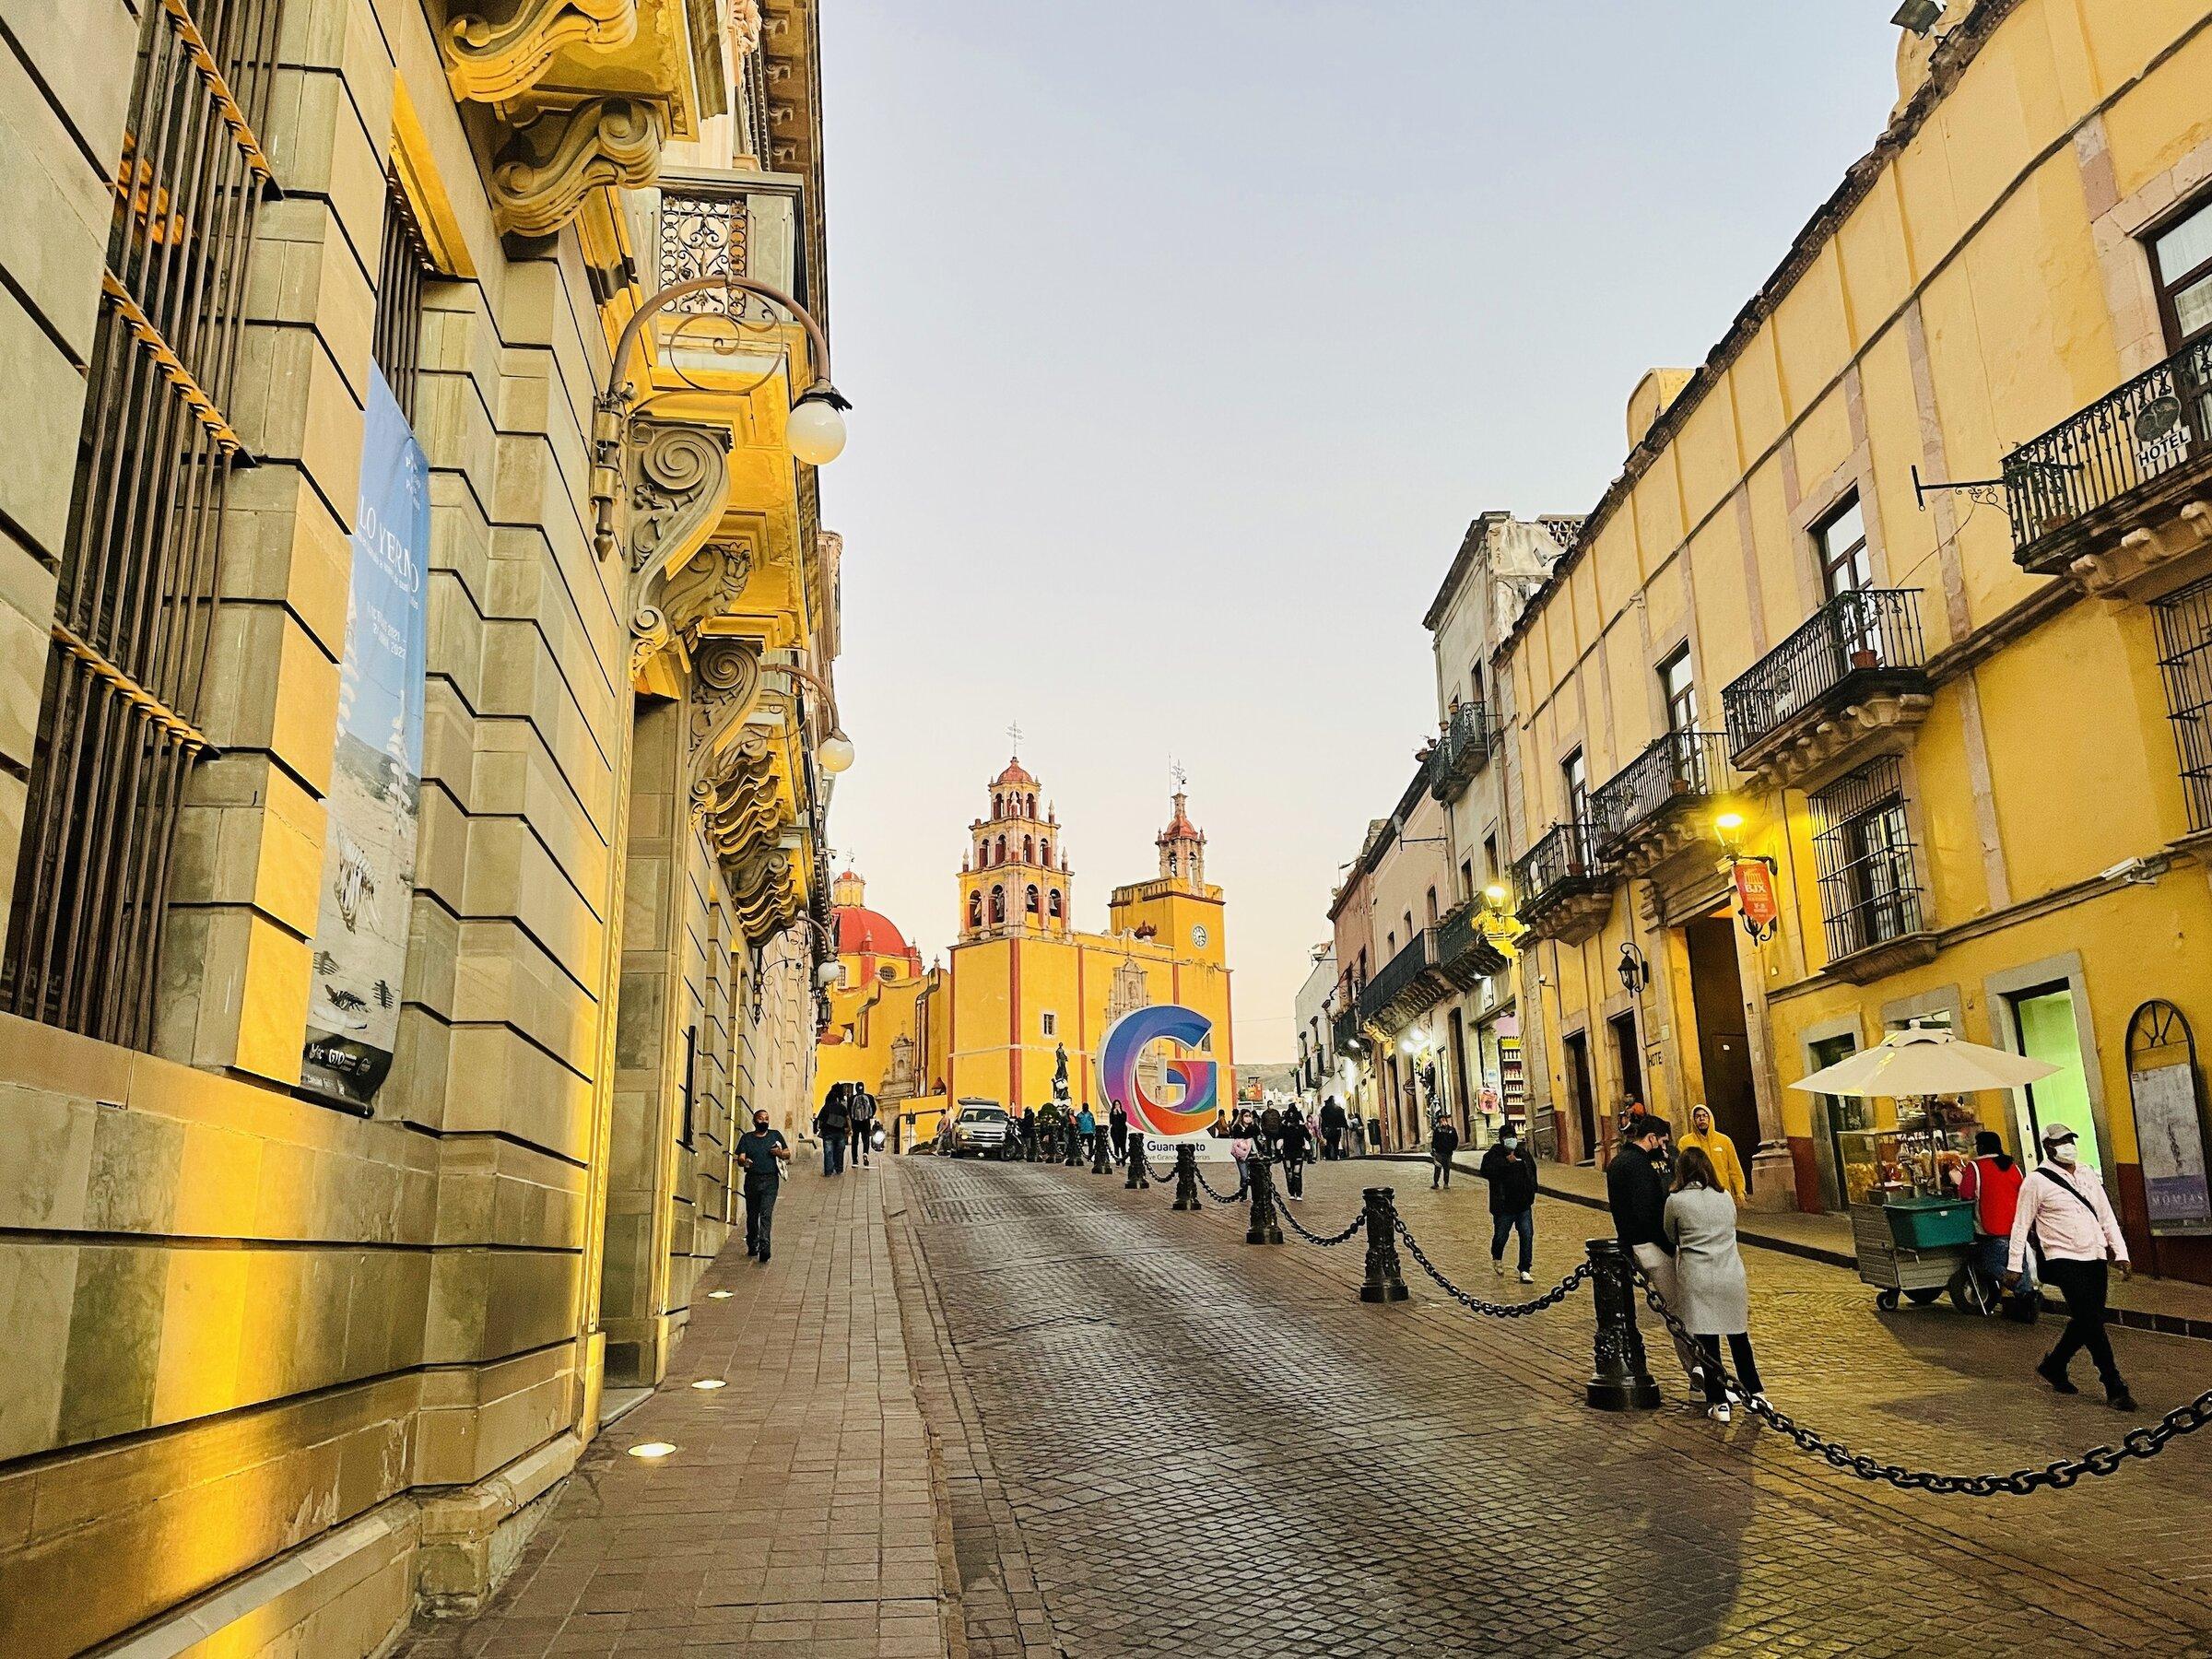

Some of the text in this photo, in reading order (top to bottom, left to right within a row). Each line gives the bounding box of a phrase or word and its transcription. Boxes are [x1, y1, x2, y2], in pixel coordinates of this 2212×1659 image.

[2138, 430, 2189, 467] HOTEL
[359, 495, 376, 539] LO
[1745, 884, 1767, 893] BJX
[1097, 1005, 1218, 1136] G
[1147, 1140, 1206, 1152] Guanto
